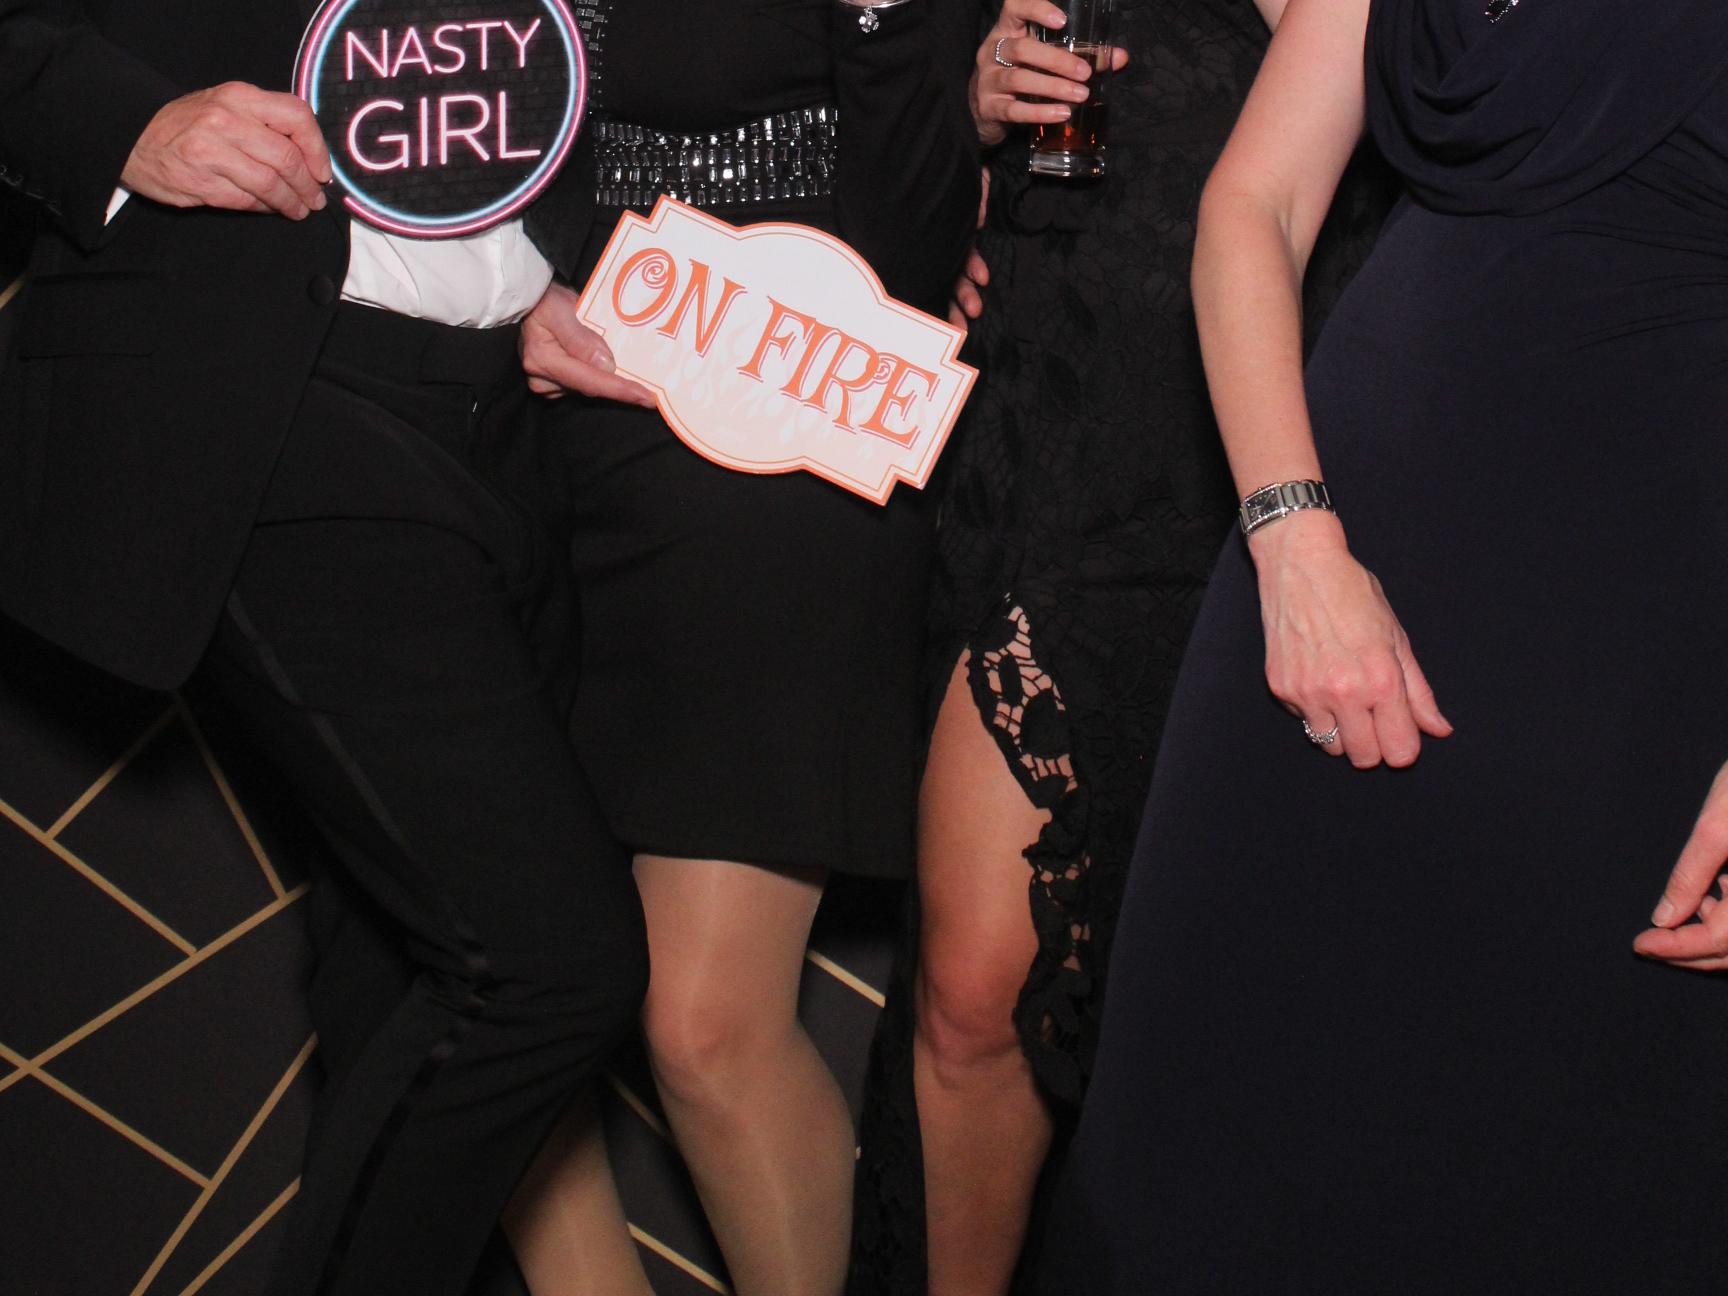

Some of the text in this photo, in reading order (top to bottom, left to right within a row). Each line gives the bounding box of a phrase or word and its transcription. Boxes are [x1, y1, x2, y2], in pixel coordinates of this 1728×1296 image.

[346, 17, 541, 81] NASTY
[347, 91, 541, 171] GIRL
[612, 247, 941, 450] ON FIRE
